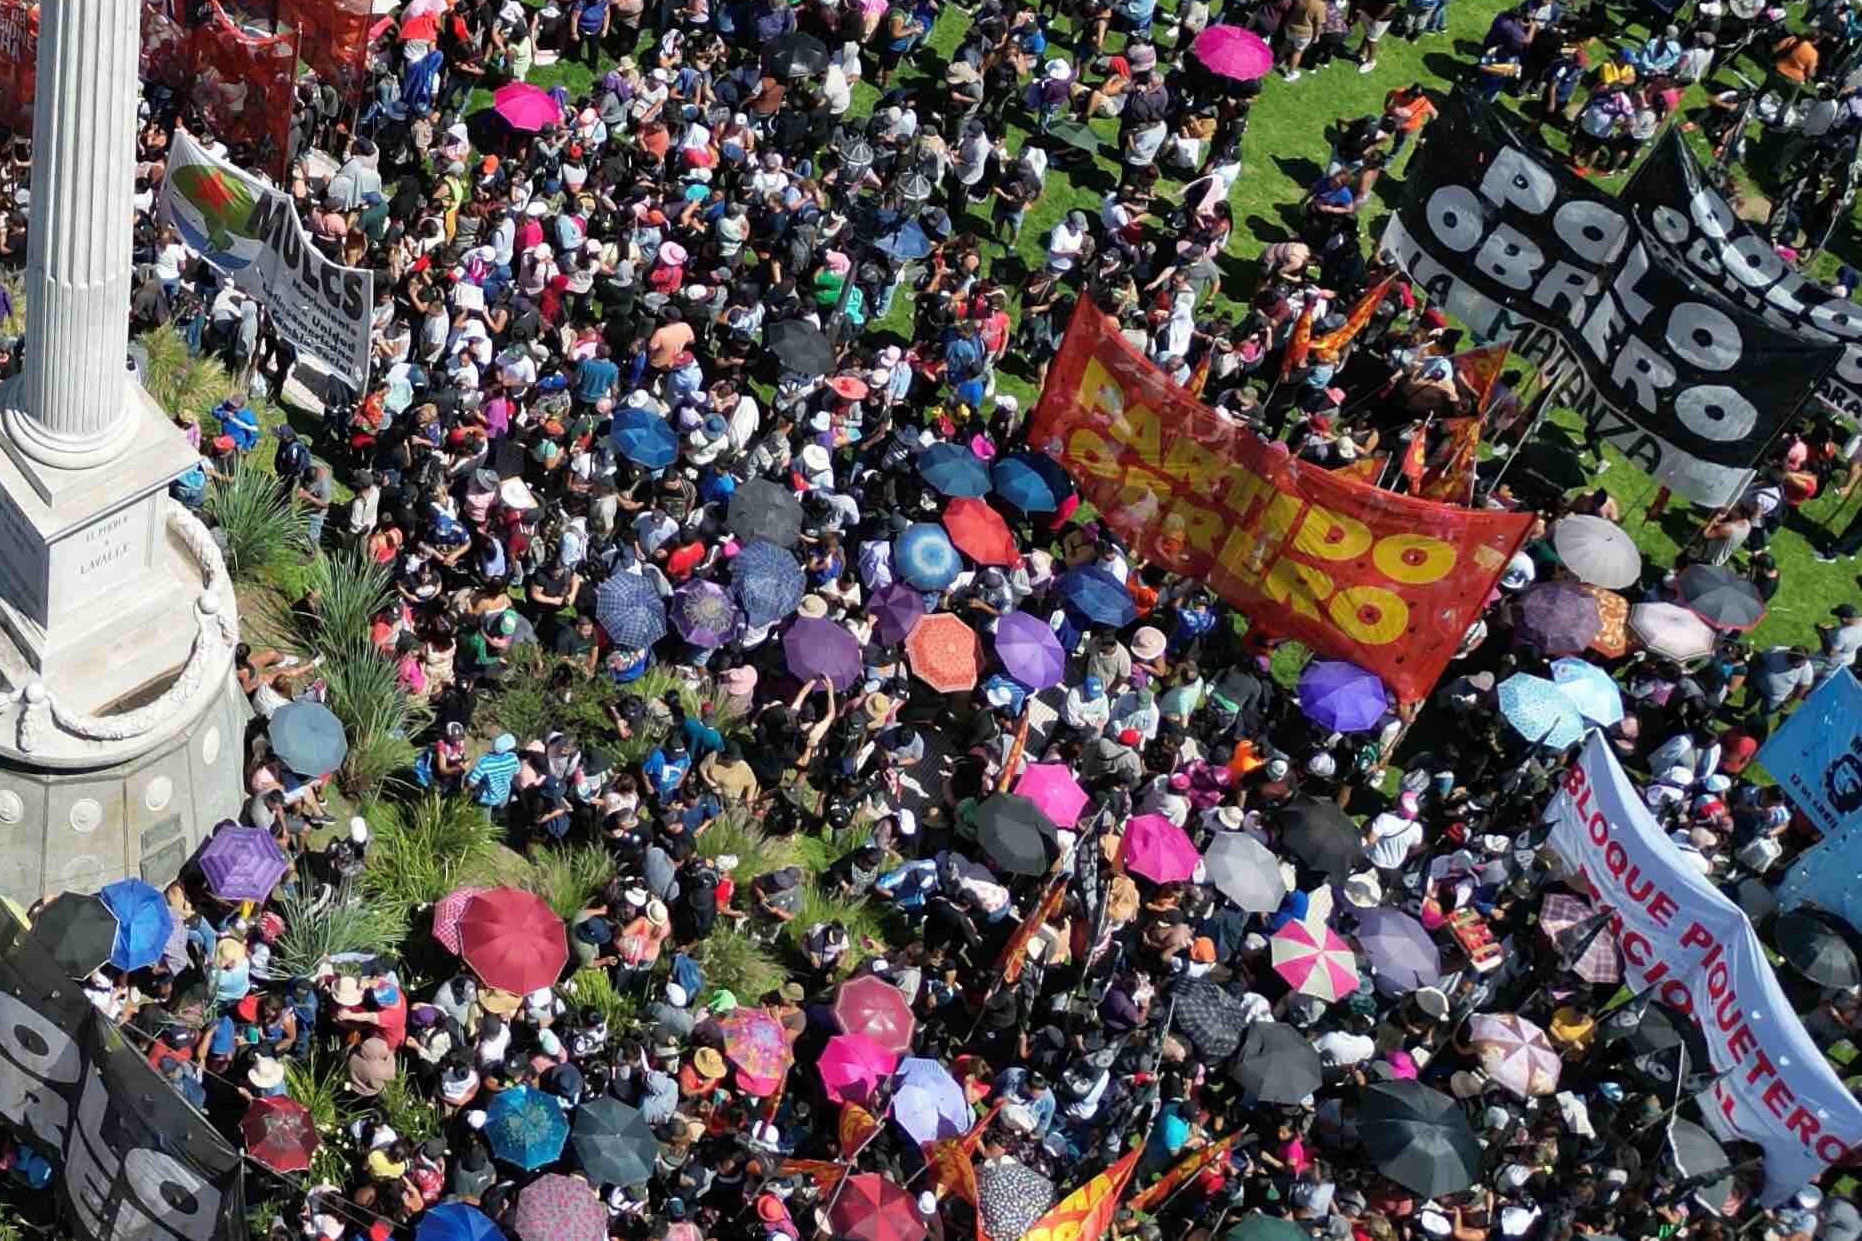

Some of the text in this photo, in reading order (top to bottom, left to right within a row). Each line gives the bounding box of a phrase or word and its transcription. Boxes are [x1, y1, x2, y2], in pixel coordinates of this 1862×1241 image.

[245, 190, 365, 322] MULCS
[1425, 184, 1759, 442] OBRERO
[1479, 144, 1744, 372] POLO
[79, 543, 130, 575] LAVALLE
[1068, 427, 1410, 645] OBRERO
[1080, 356, 1458, 585] PARTIDO
[1561, 760, 1681, 928] BLOQUE
